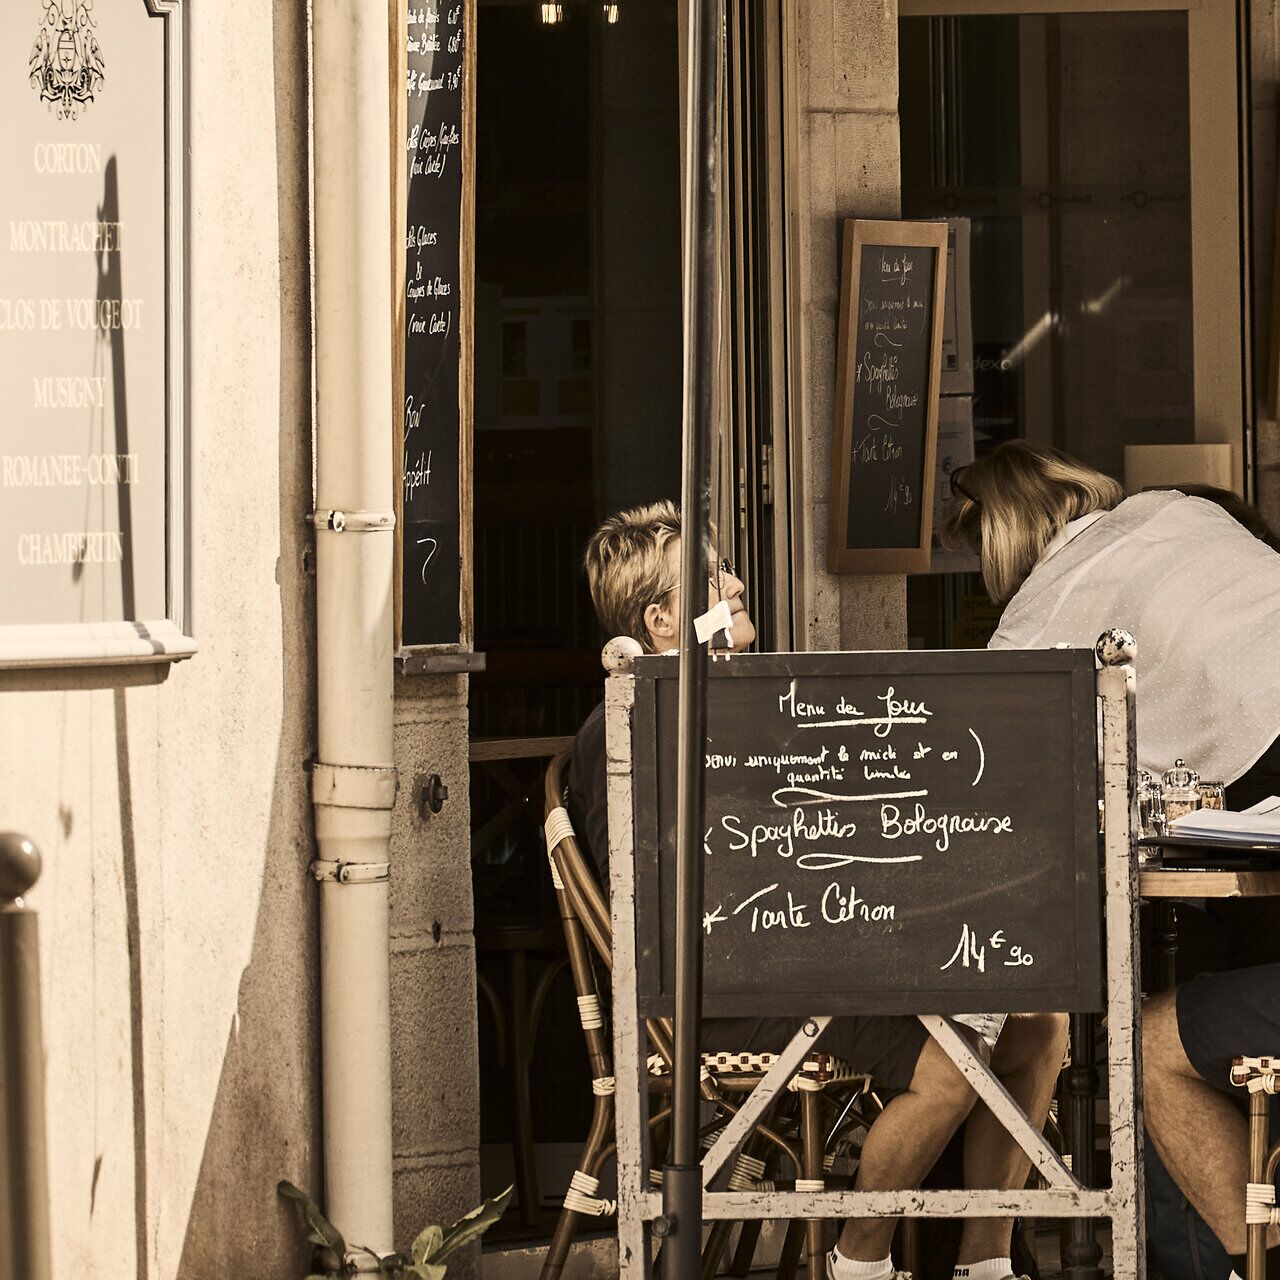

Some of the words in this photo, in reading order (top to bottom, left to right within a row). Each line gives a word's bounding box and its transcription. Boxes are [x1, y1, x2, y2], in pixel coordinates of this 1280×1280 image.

[33, 142, 103, 175] CORTON
[9, 220, 125, 253] MONTRACHET
[0, 299, 36, 331] CLOS
[40, 299, 62, 331] DE
[66, 299, 145, 331] VOUGEOT
[32, 376, 107, 409] MUSIGNY
[2, 453, 141, 488] ROMANEE-CONTI
[17, 532, 125, 566] CHAMBERTIN
[778, 677, 826, 719] Menu
[875, 686, 933, 739] Jour
[721, 807, 858, 858] Spaghettis
[881, 802, 1015, 853] Bolognaise
[732, 882, 812, 933] Tarte
[821, 881, 897, 926] Citron
